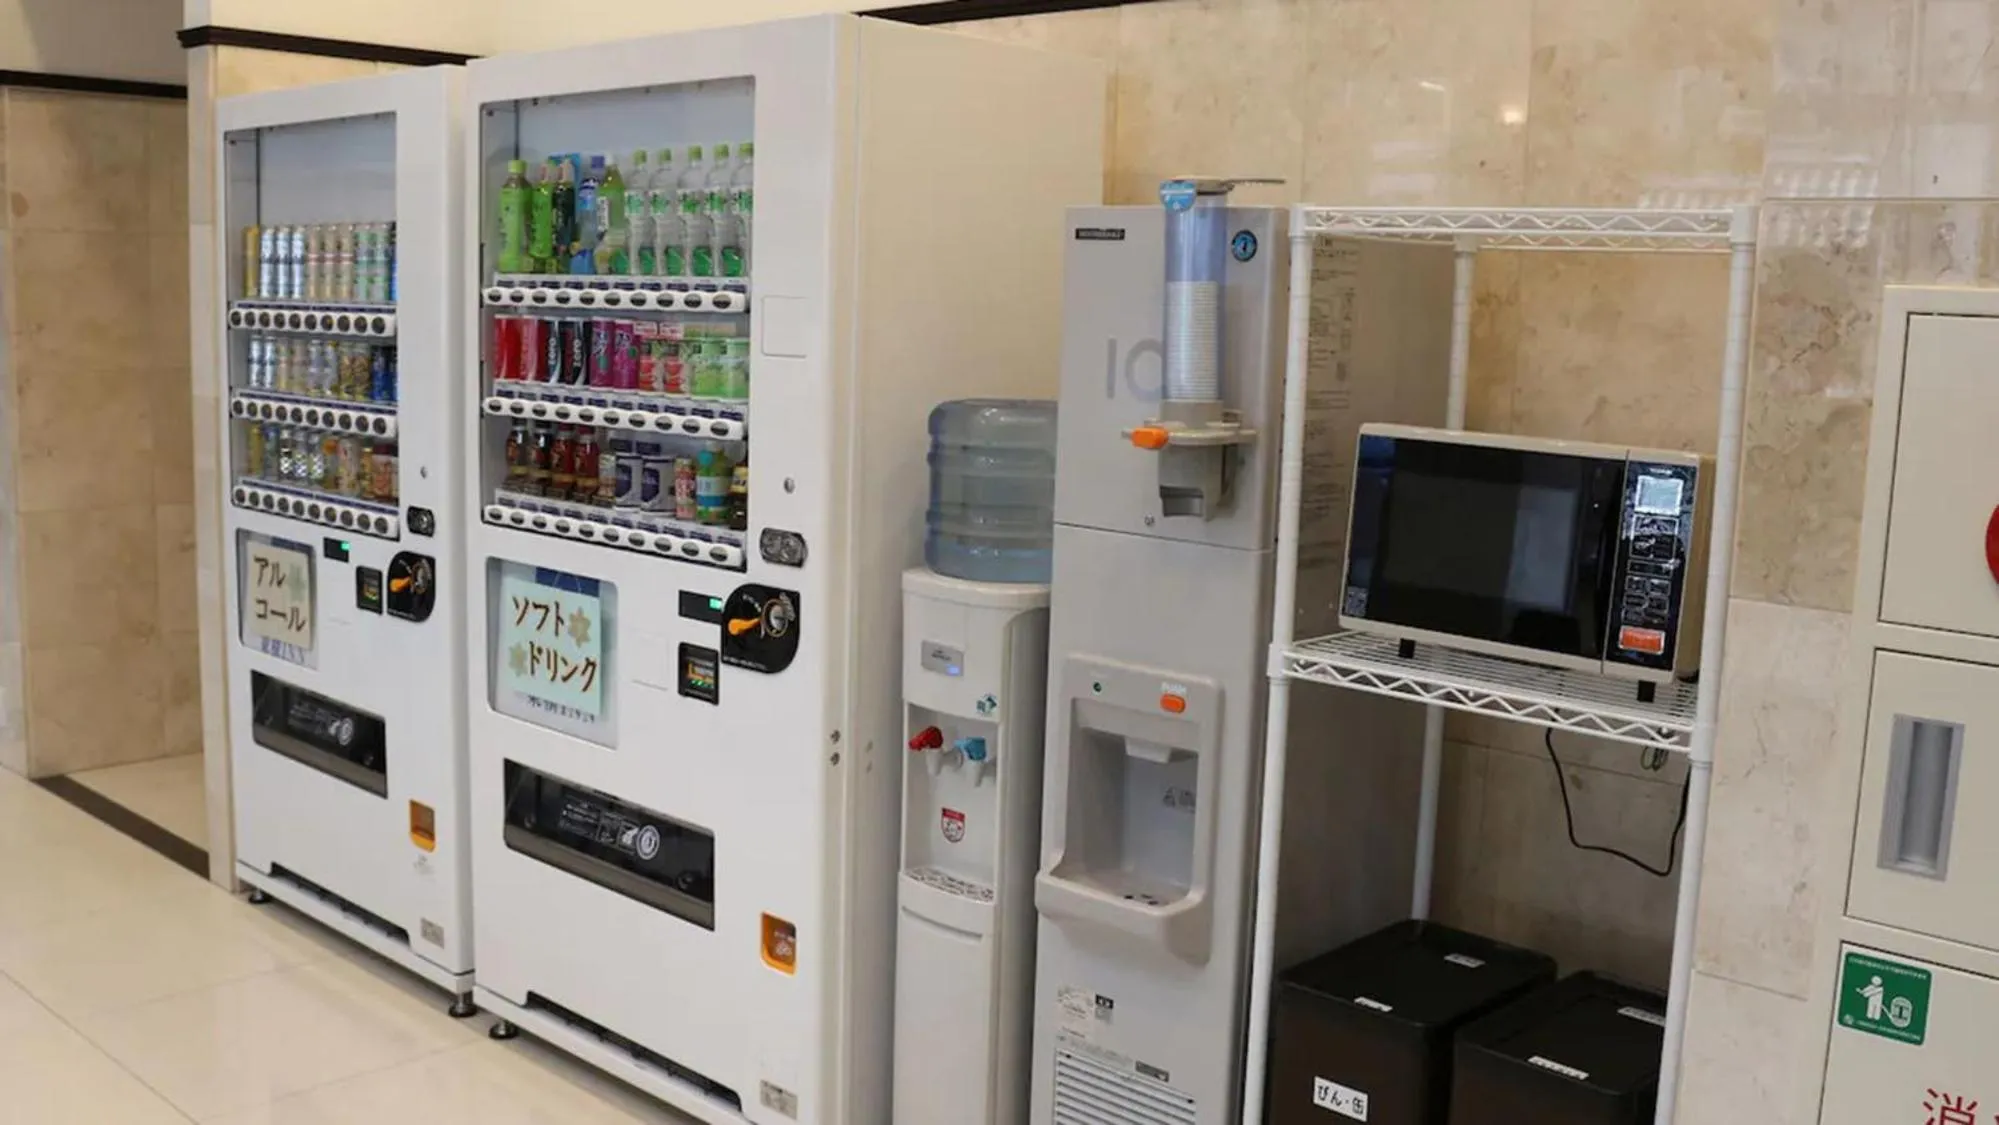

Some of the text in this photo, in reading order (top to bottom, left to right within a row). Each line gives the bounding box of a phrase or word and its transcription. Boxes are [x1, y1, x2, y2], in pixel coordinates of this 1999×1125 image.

[253, 555, 287, 588] アル
[255, 598, 307, 632] コール
[512, 596, 565, 637] ソフト
[529, 641, 598, 692] ドリンク
